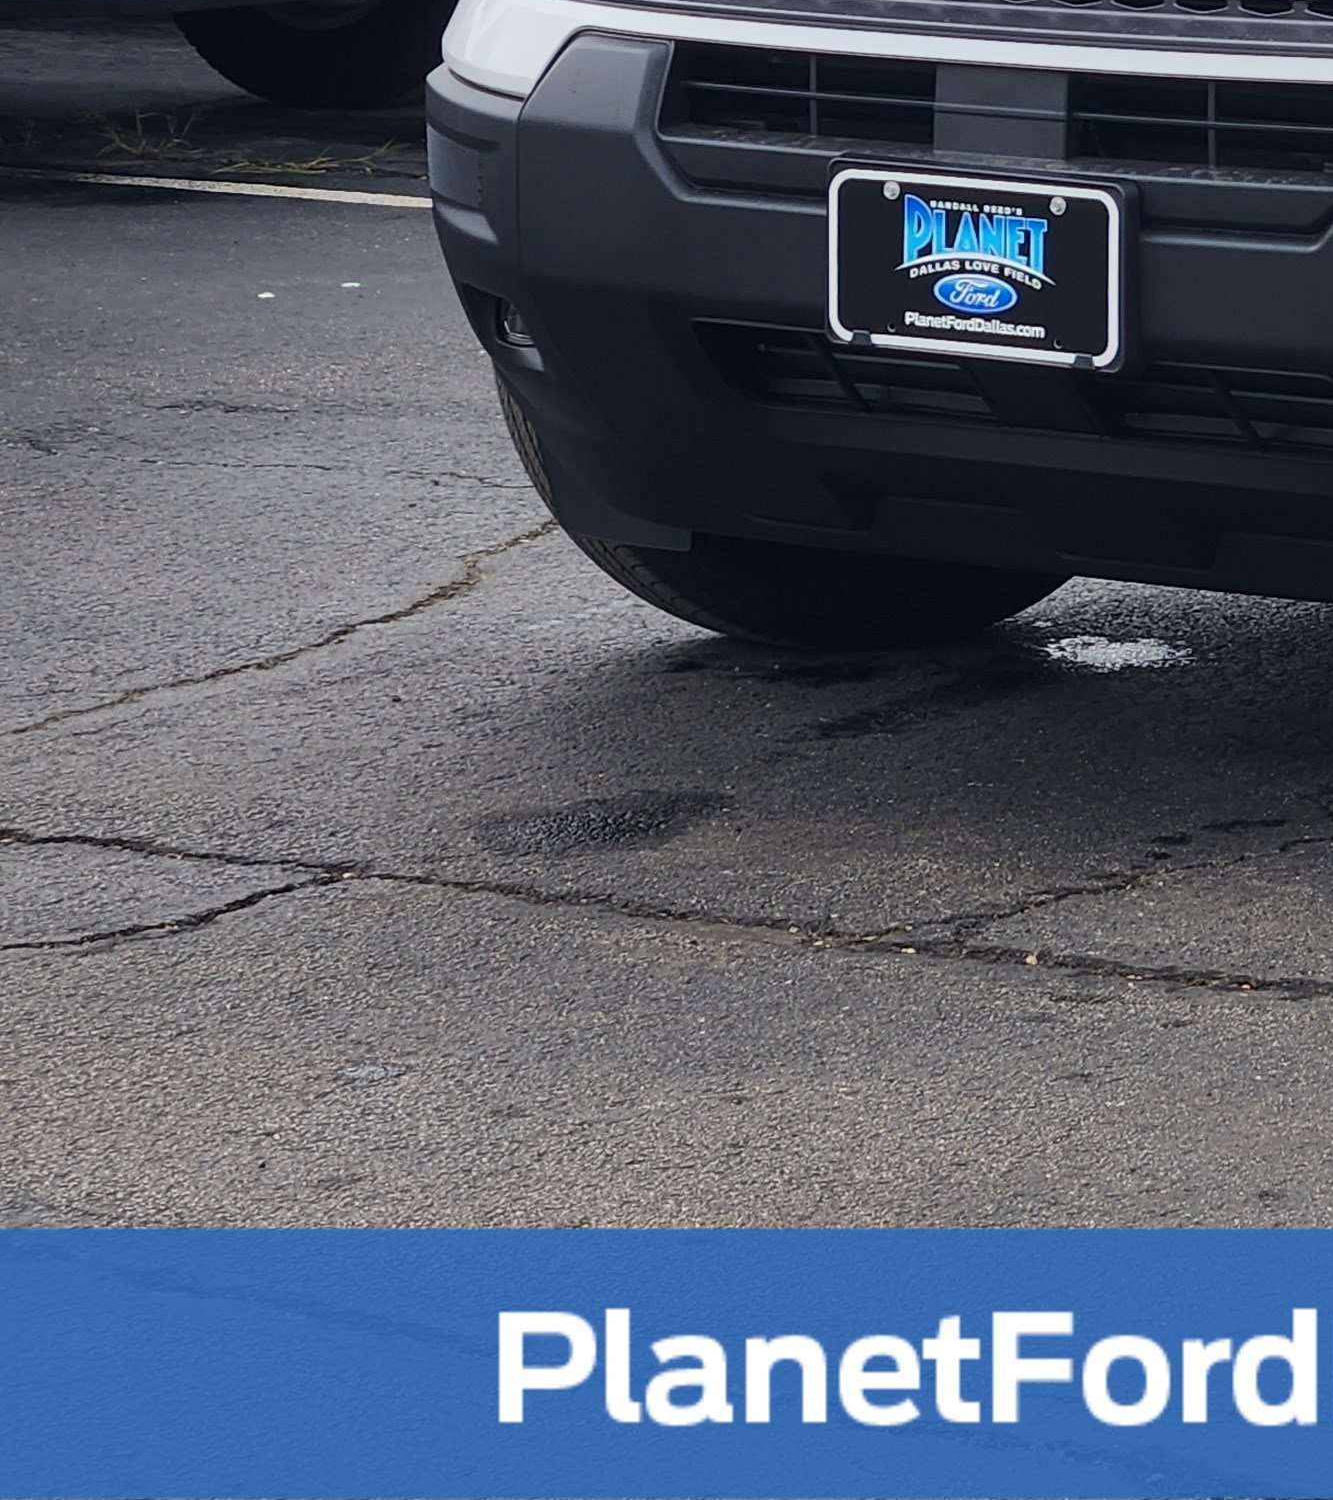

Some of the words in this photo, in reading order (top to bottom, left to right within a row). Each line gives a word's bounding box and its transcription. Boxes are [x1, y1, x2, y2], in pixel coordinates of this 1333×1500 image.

[904, 194, 1048, 275] PLANET
[909, 260, 961, 279] DALLAS
[964, 260, 1000, 274] LOVE
[1003, 267, 1043, 291] FIELD
[949, 278, 1001, 309] Ford
[904, 311, 1046, 340] PlanetFordDallas.com
